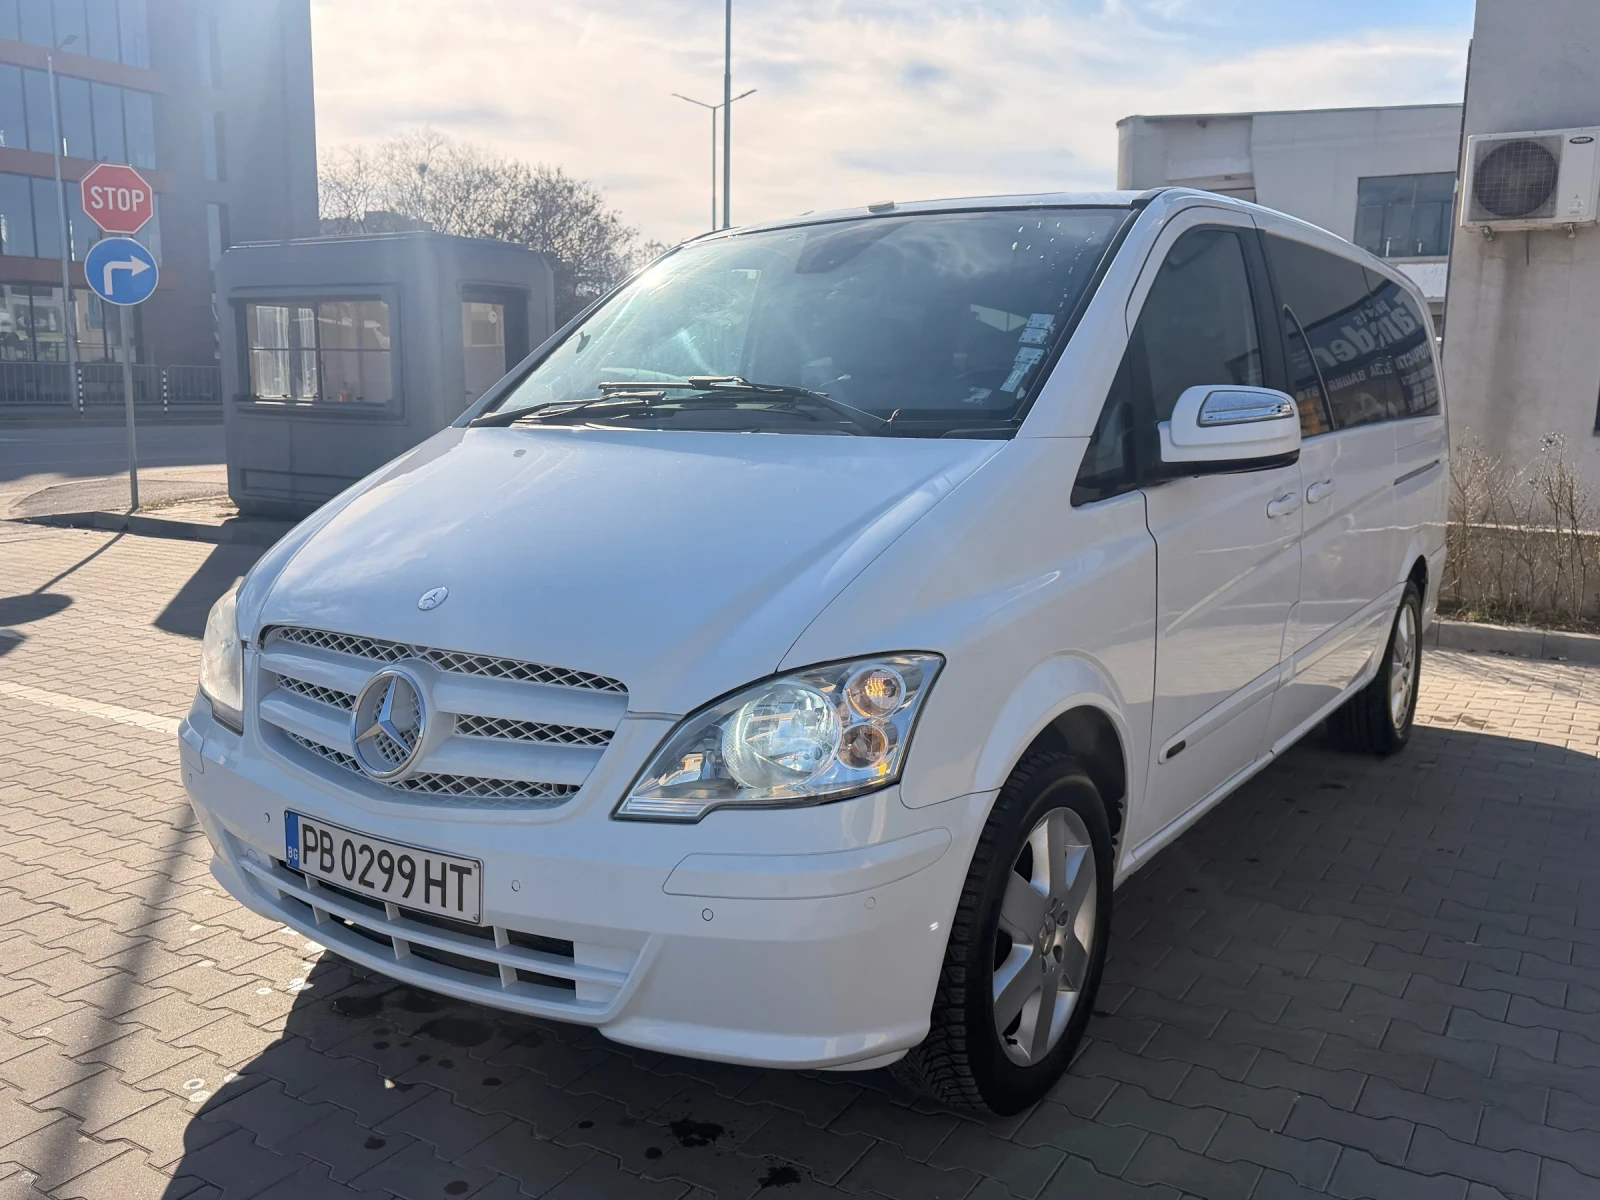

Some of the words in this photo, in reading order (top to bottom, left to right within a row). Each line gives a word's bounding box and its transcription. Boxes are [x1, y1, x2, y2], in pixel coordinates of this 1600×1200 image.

[90, 185, 145, 212] STOP
[287, 845, 299, 861] BG
[302, 823, 335, 874] PB
[341, 838, 416, 898] 0299
[424, 858, 472, 912] HT
